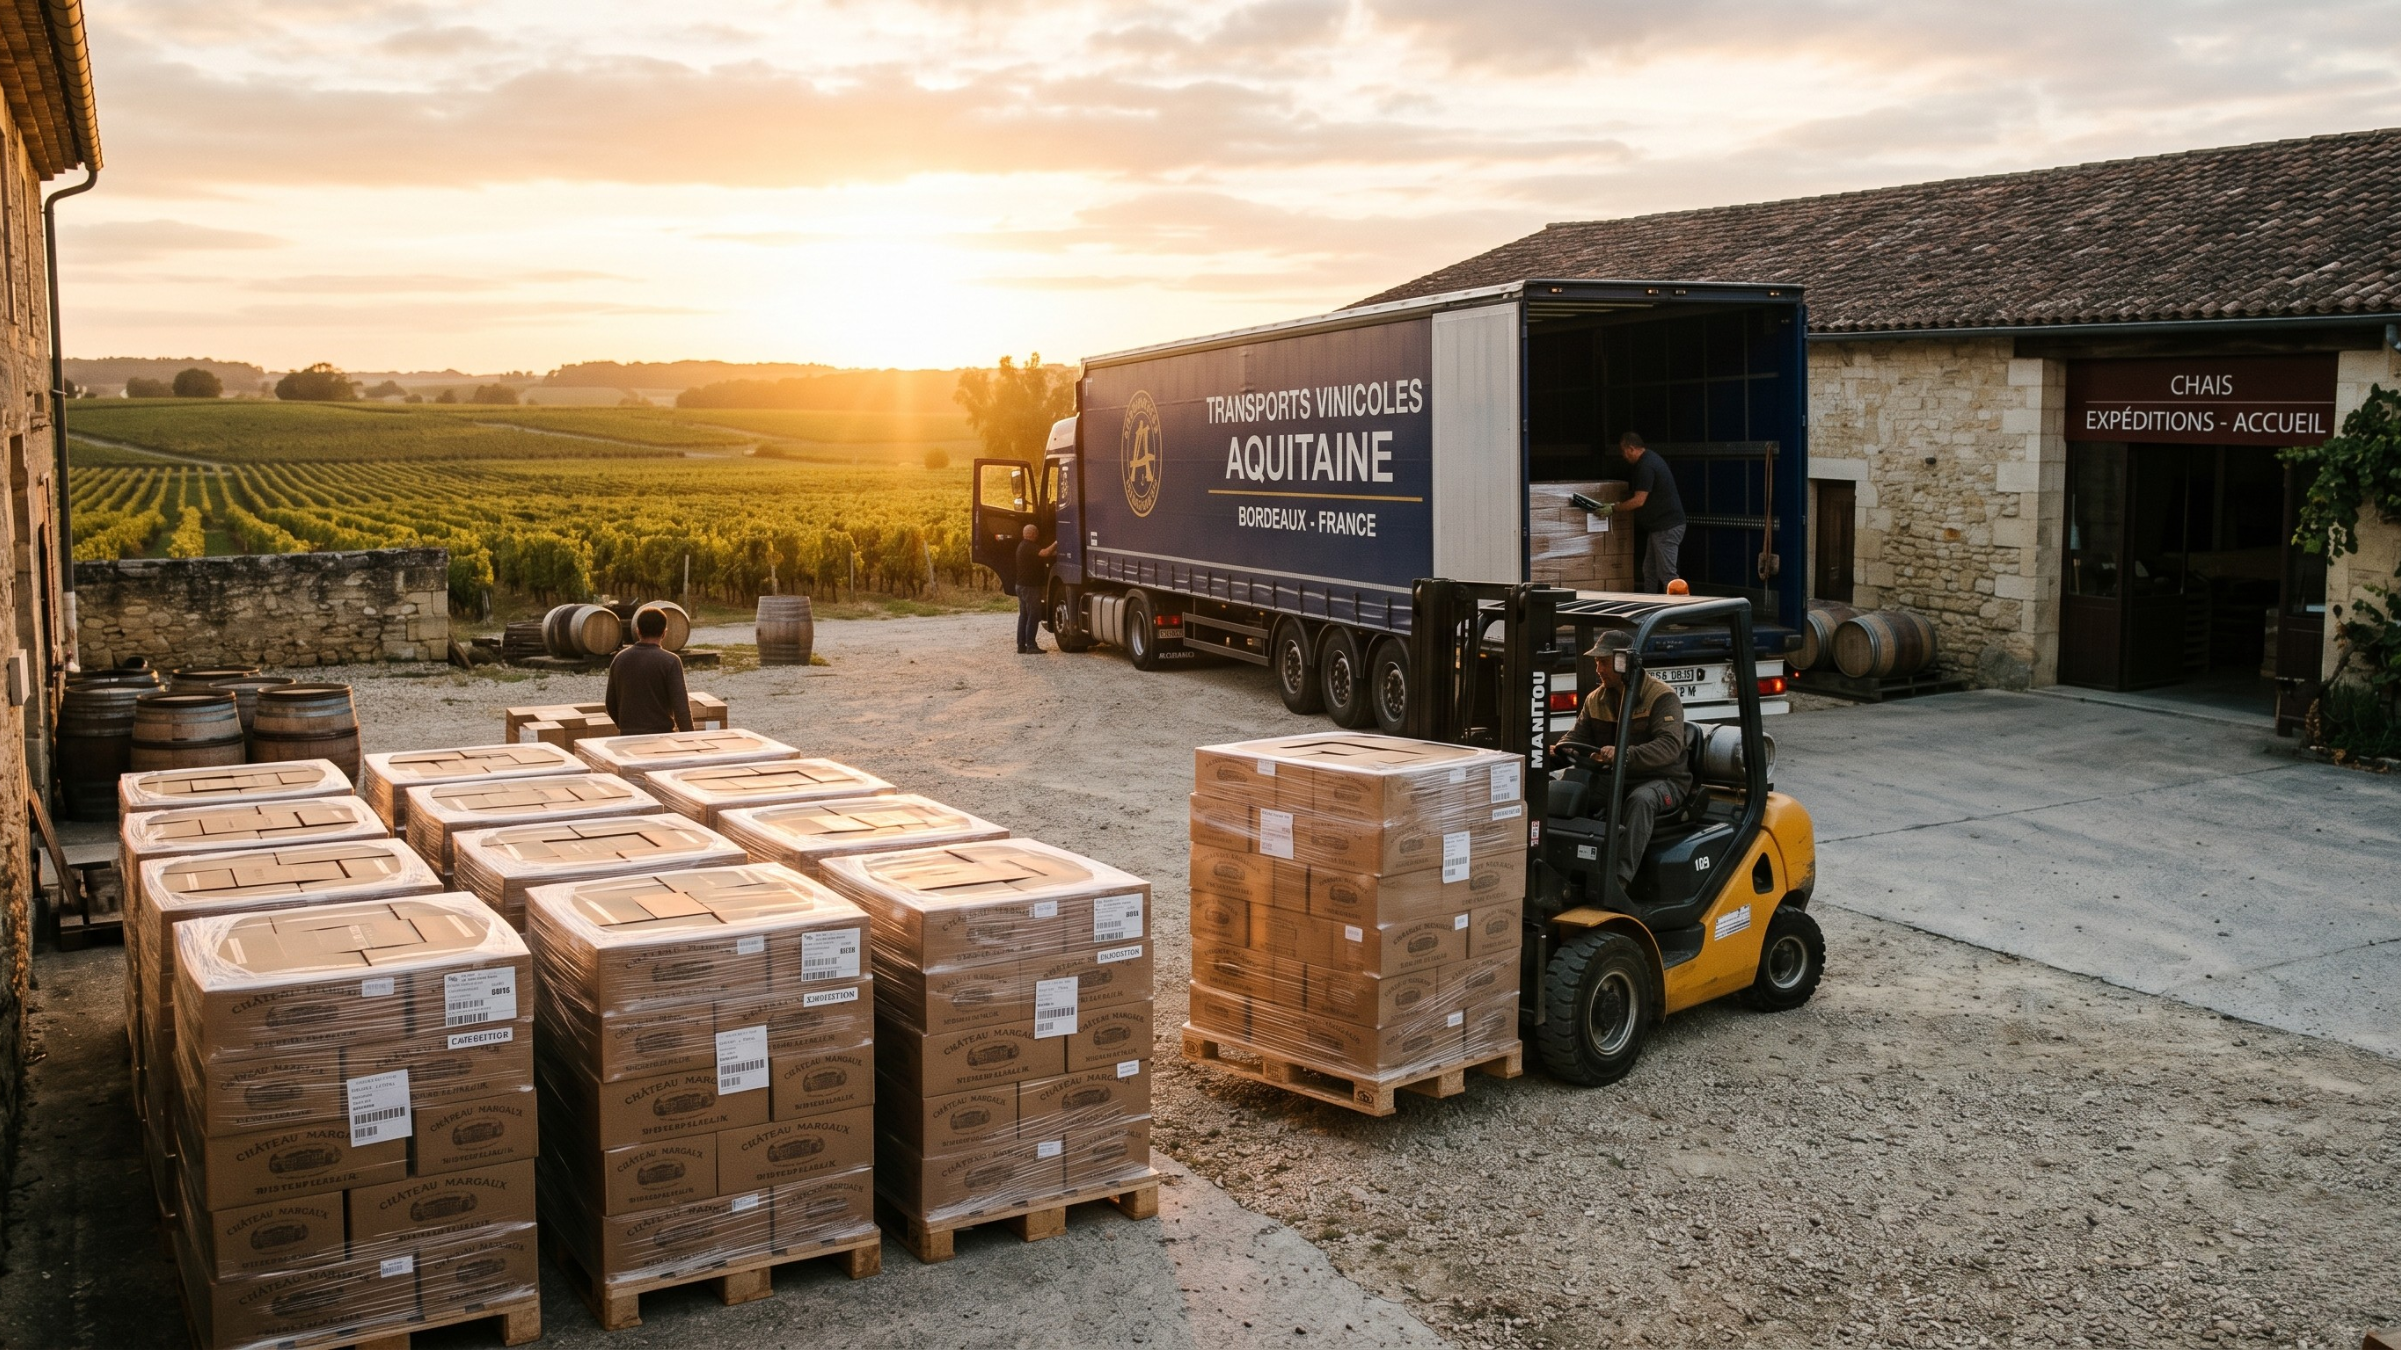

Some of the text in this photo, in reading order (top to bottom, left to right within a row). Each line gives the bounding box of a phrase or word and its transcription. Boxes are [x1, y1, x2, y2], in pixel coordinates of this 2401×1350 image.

[1206, 387, 1311, 424] TRANSPORTS
[1316, 377, 1423, 418] VINICOLES
[2170, 374, 2233, 396] CHAIS
[2086, 405, 2215, 432] EXPÉDITIONS
[2232, 411, 2327, 434] ACCUEIL
[1225, 430, 1394, 484] AQUITAINE
[1238, 505, 1306, 532] BORDEAUX
[1318, 509, 1377, 537] FRANCE
[1531, 671, 1546, 769] MANITOU
[1694, 855, 1710, 872] 109
